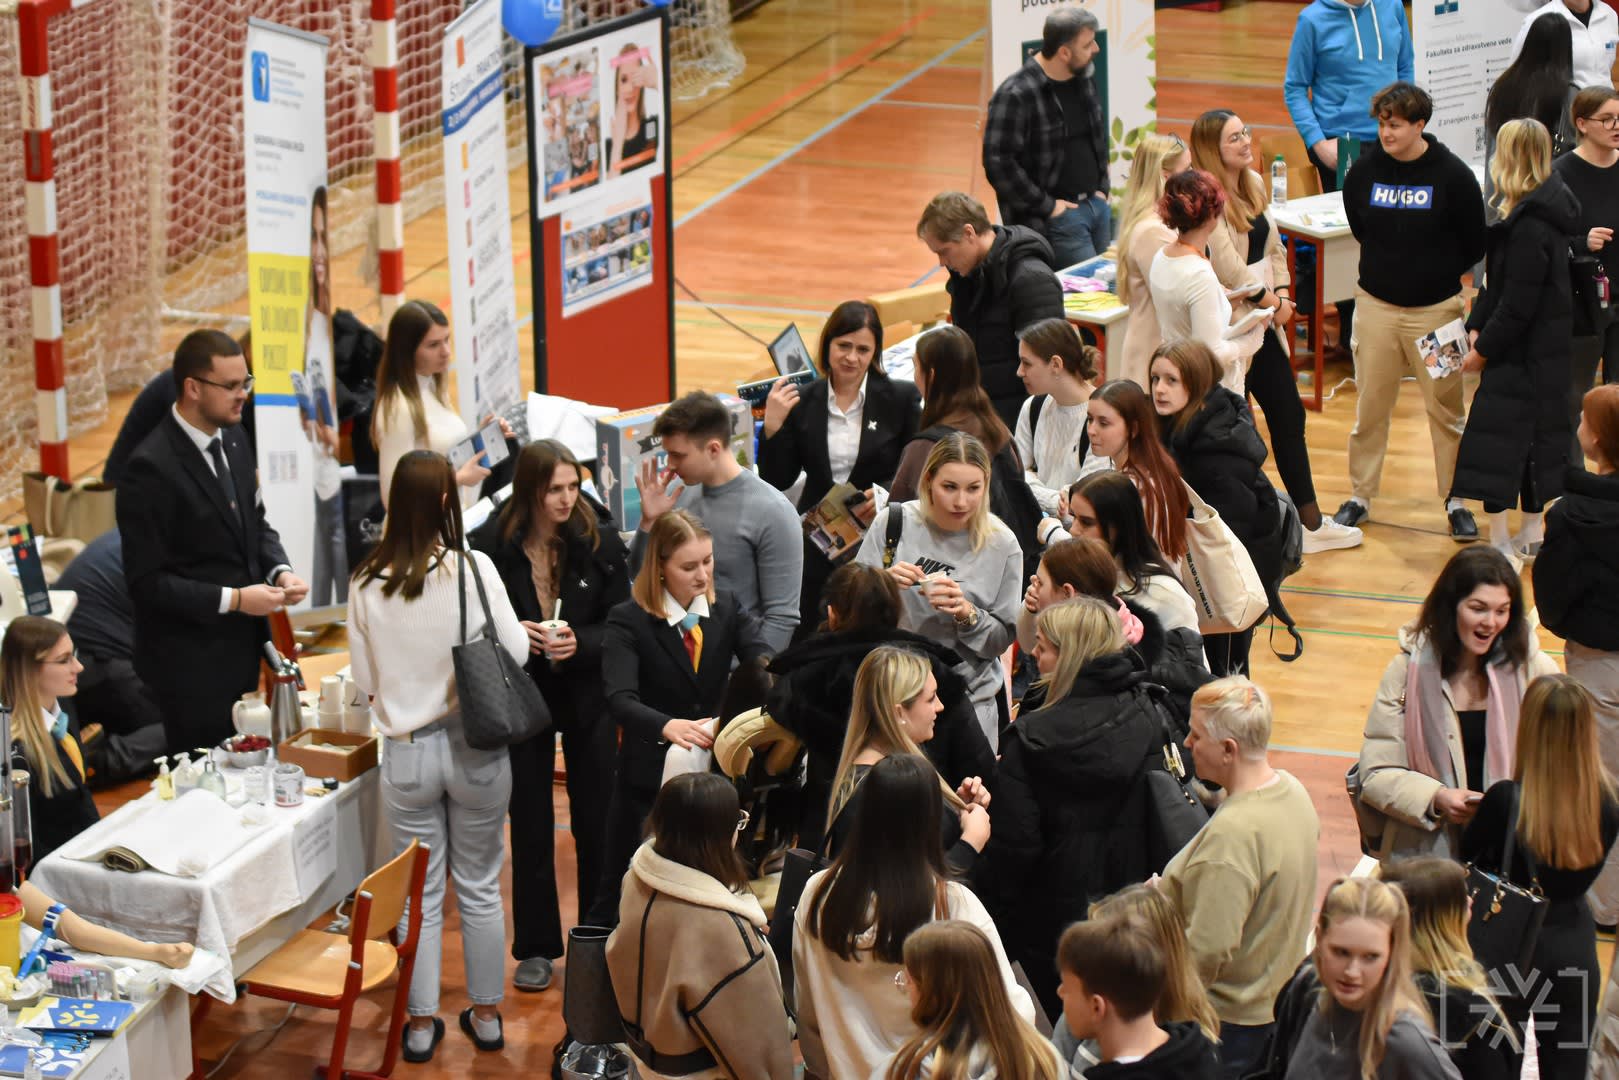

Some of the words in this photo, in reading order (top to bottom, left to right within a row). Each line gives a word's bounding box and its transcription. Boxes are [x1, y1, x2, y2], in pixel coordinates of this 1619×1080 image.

[1425, 47, 1453, 59] Fakulteta
[1461, 39, 1497, 53] zdravstvene
[1498, 37, 1512, 46] vede
[1374, 187, 1429, 205] HUGO
